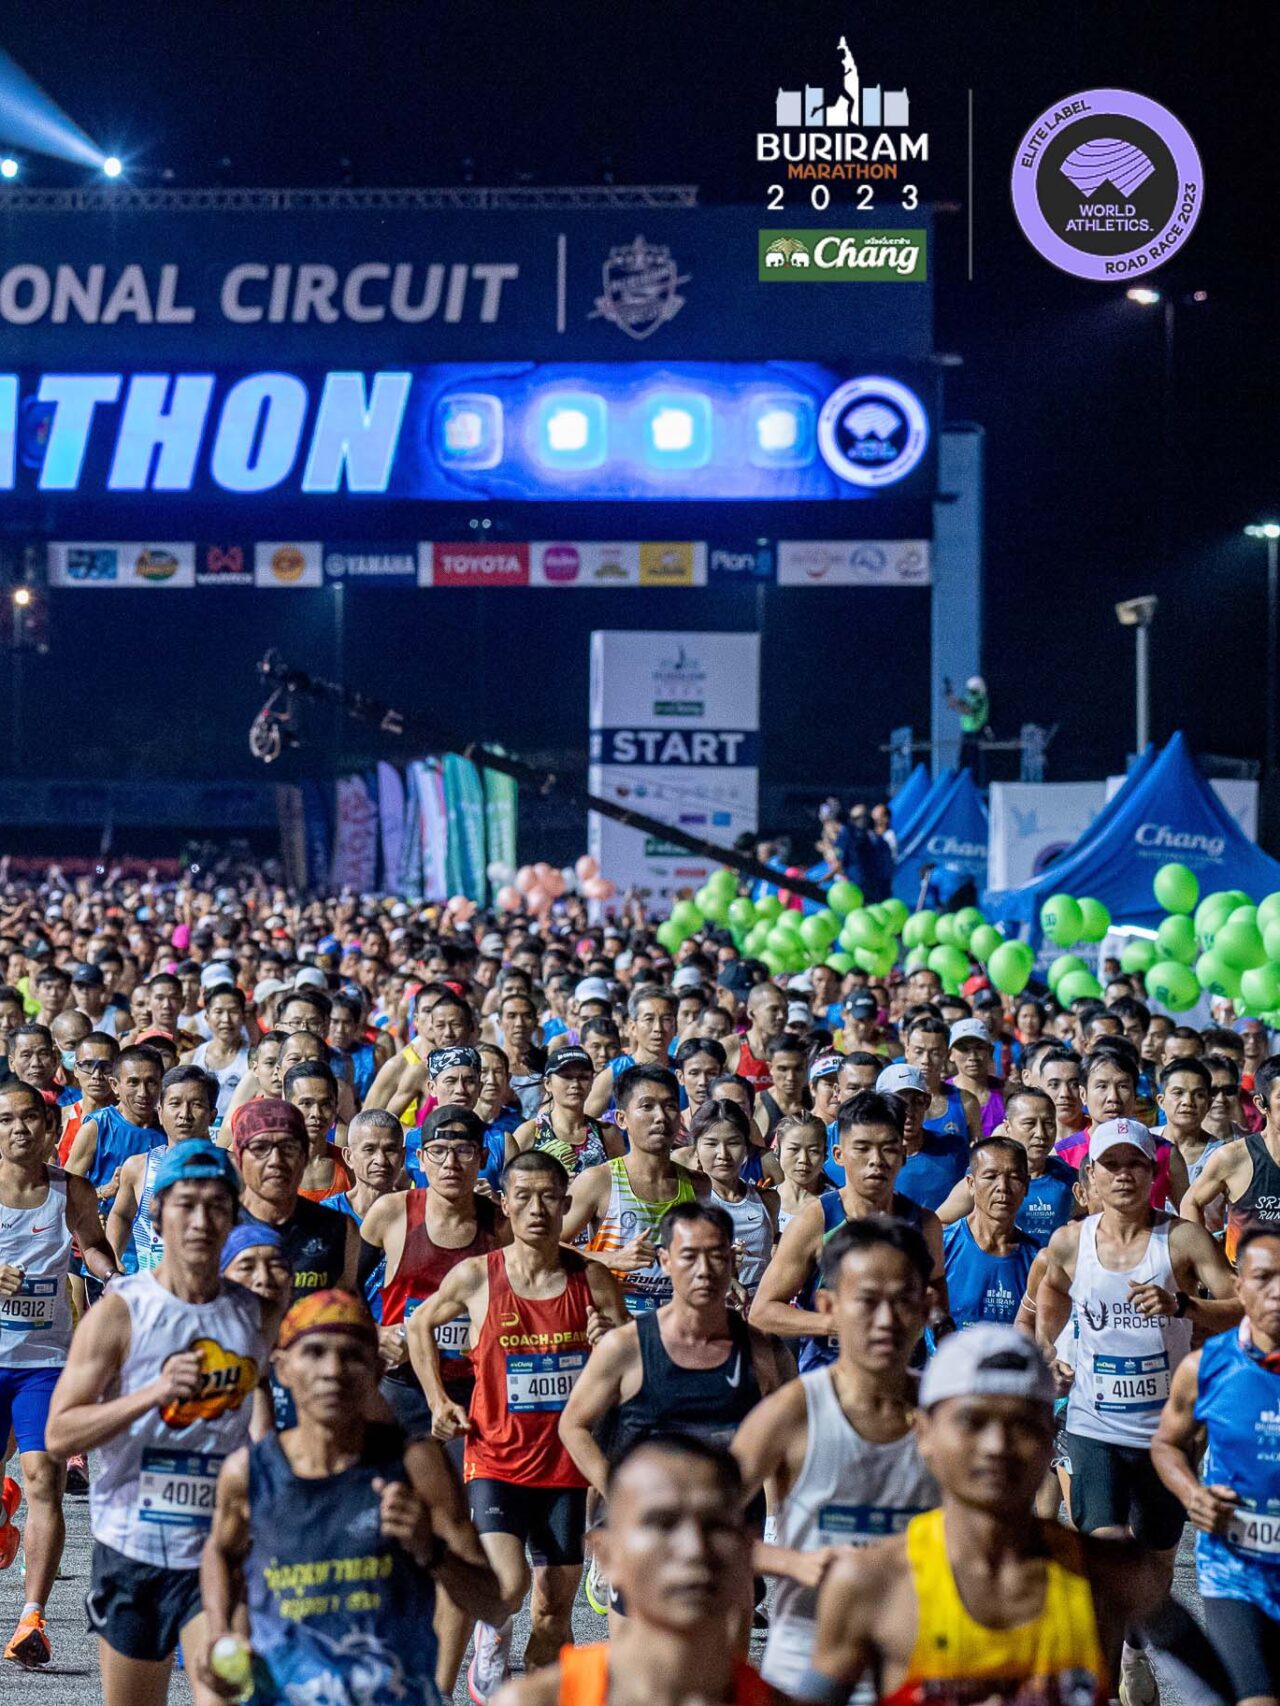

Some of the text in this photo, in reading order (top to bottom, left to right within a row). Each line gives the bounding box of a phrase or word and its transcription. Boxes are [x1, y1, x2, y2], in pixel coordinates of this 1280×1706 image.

[221, 262, 520, 323] CIRCUIT
[347, 555, 416, 576] YAMAHA
[441, 555, 521, 574] TOYOTA
[613, 731, 746, 764] START
[927, 835, 987, 858] Chan
[1135, 822, 1225, 857] Chang
[1, 1300, 46, 1318] 40312
[1113, 1316, 1172, 1329] PROJECT
[1112, 1378, 1157, 1399] 41145
[162, 1480, 217, 1508] 4012
